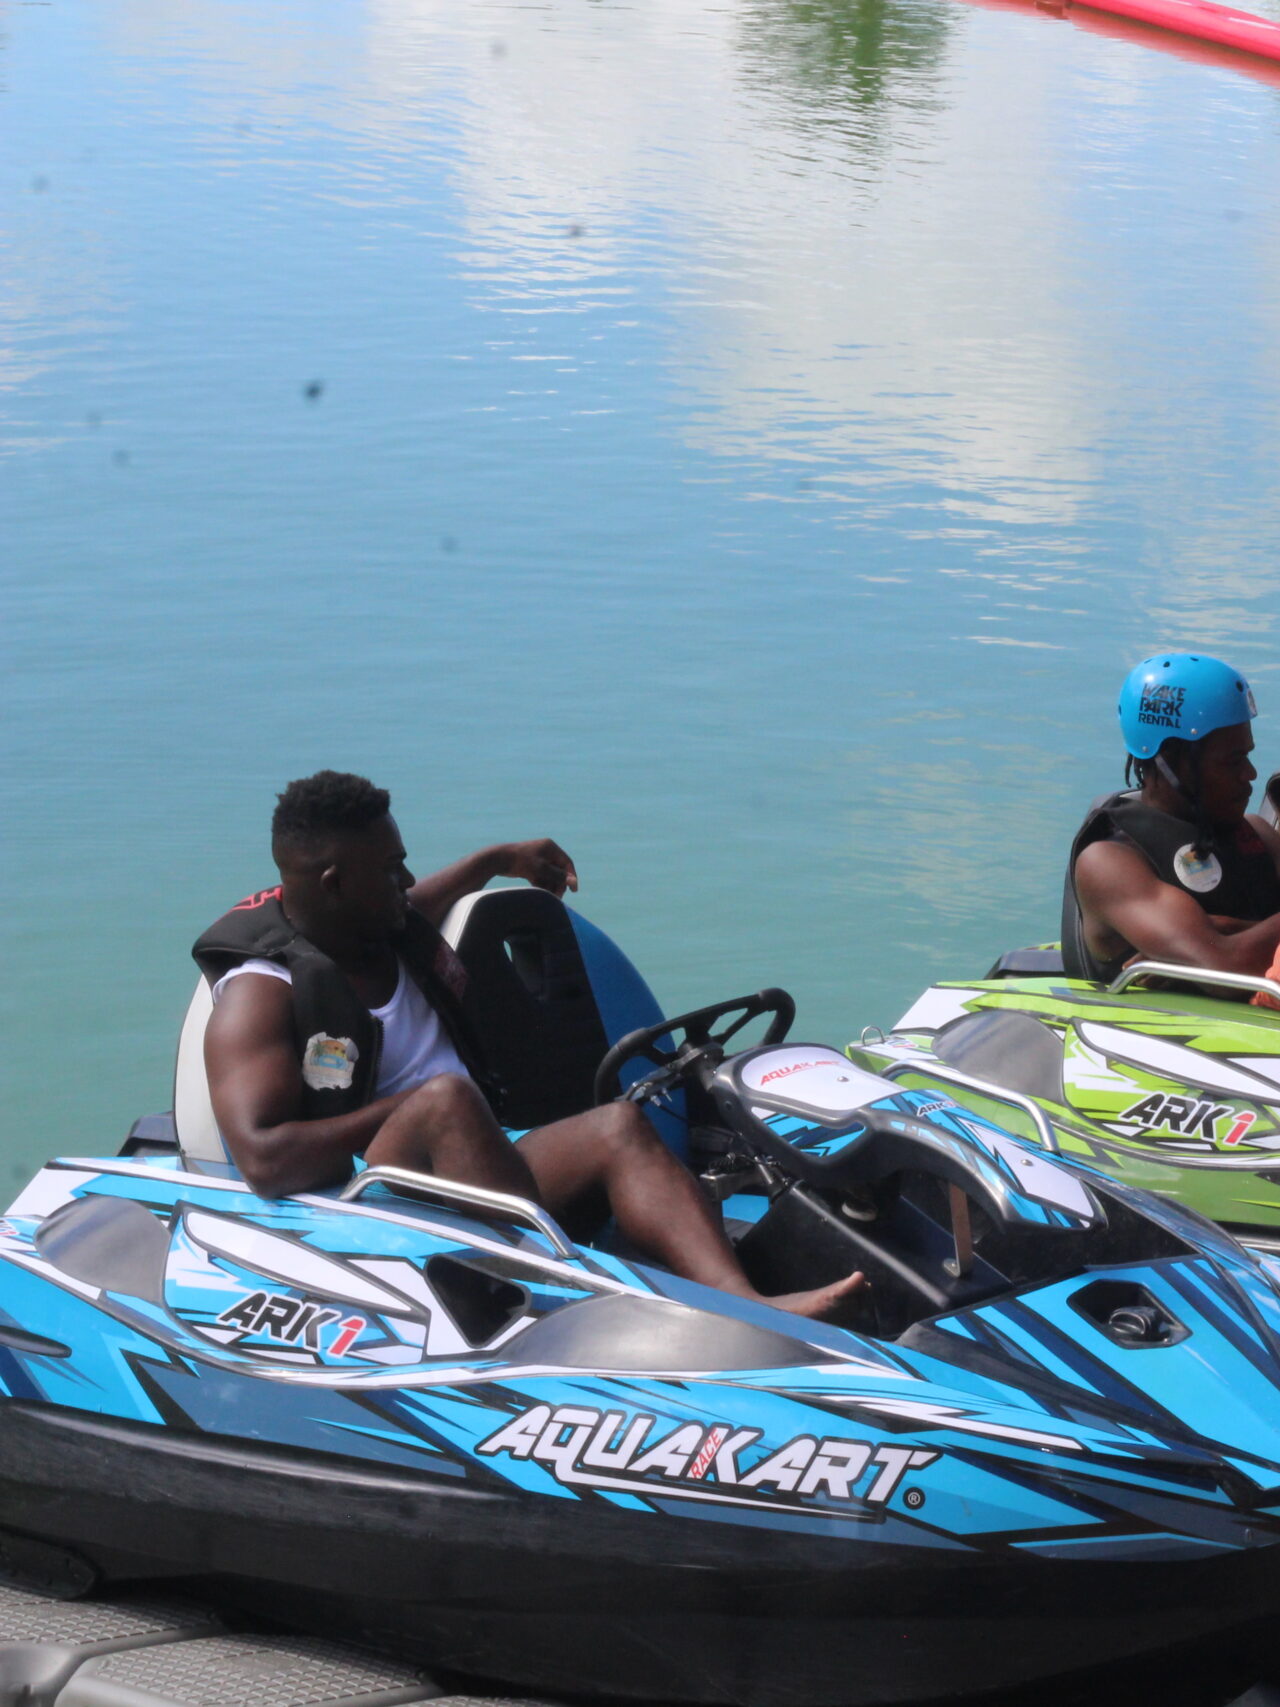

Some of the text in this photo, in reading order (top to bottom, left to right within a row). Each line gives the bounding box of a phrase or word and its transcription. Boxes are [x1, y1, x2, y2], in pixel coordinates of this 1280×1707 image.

[1138, 712, 1182, 729] RENTAL
[1140, 697, 1184, 718] PARK
[476, 1405, 942, 1508] AQUAKART
[689, 1426, 723, 1480] RACE
